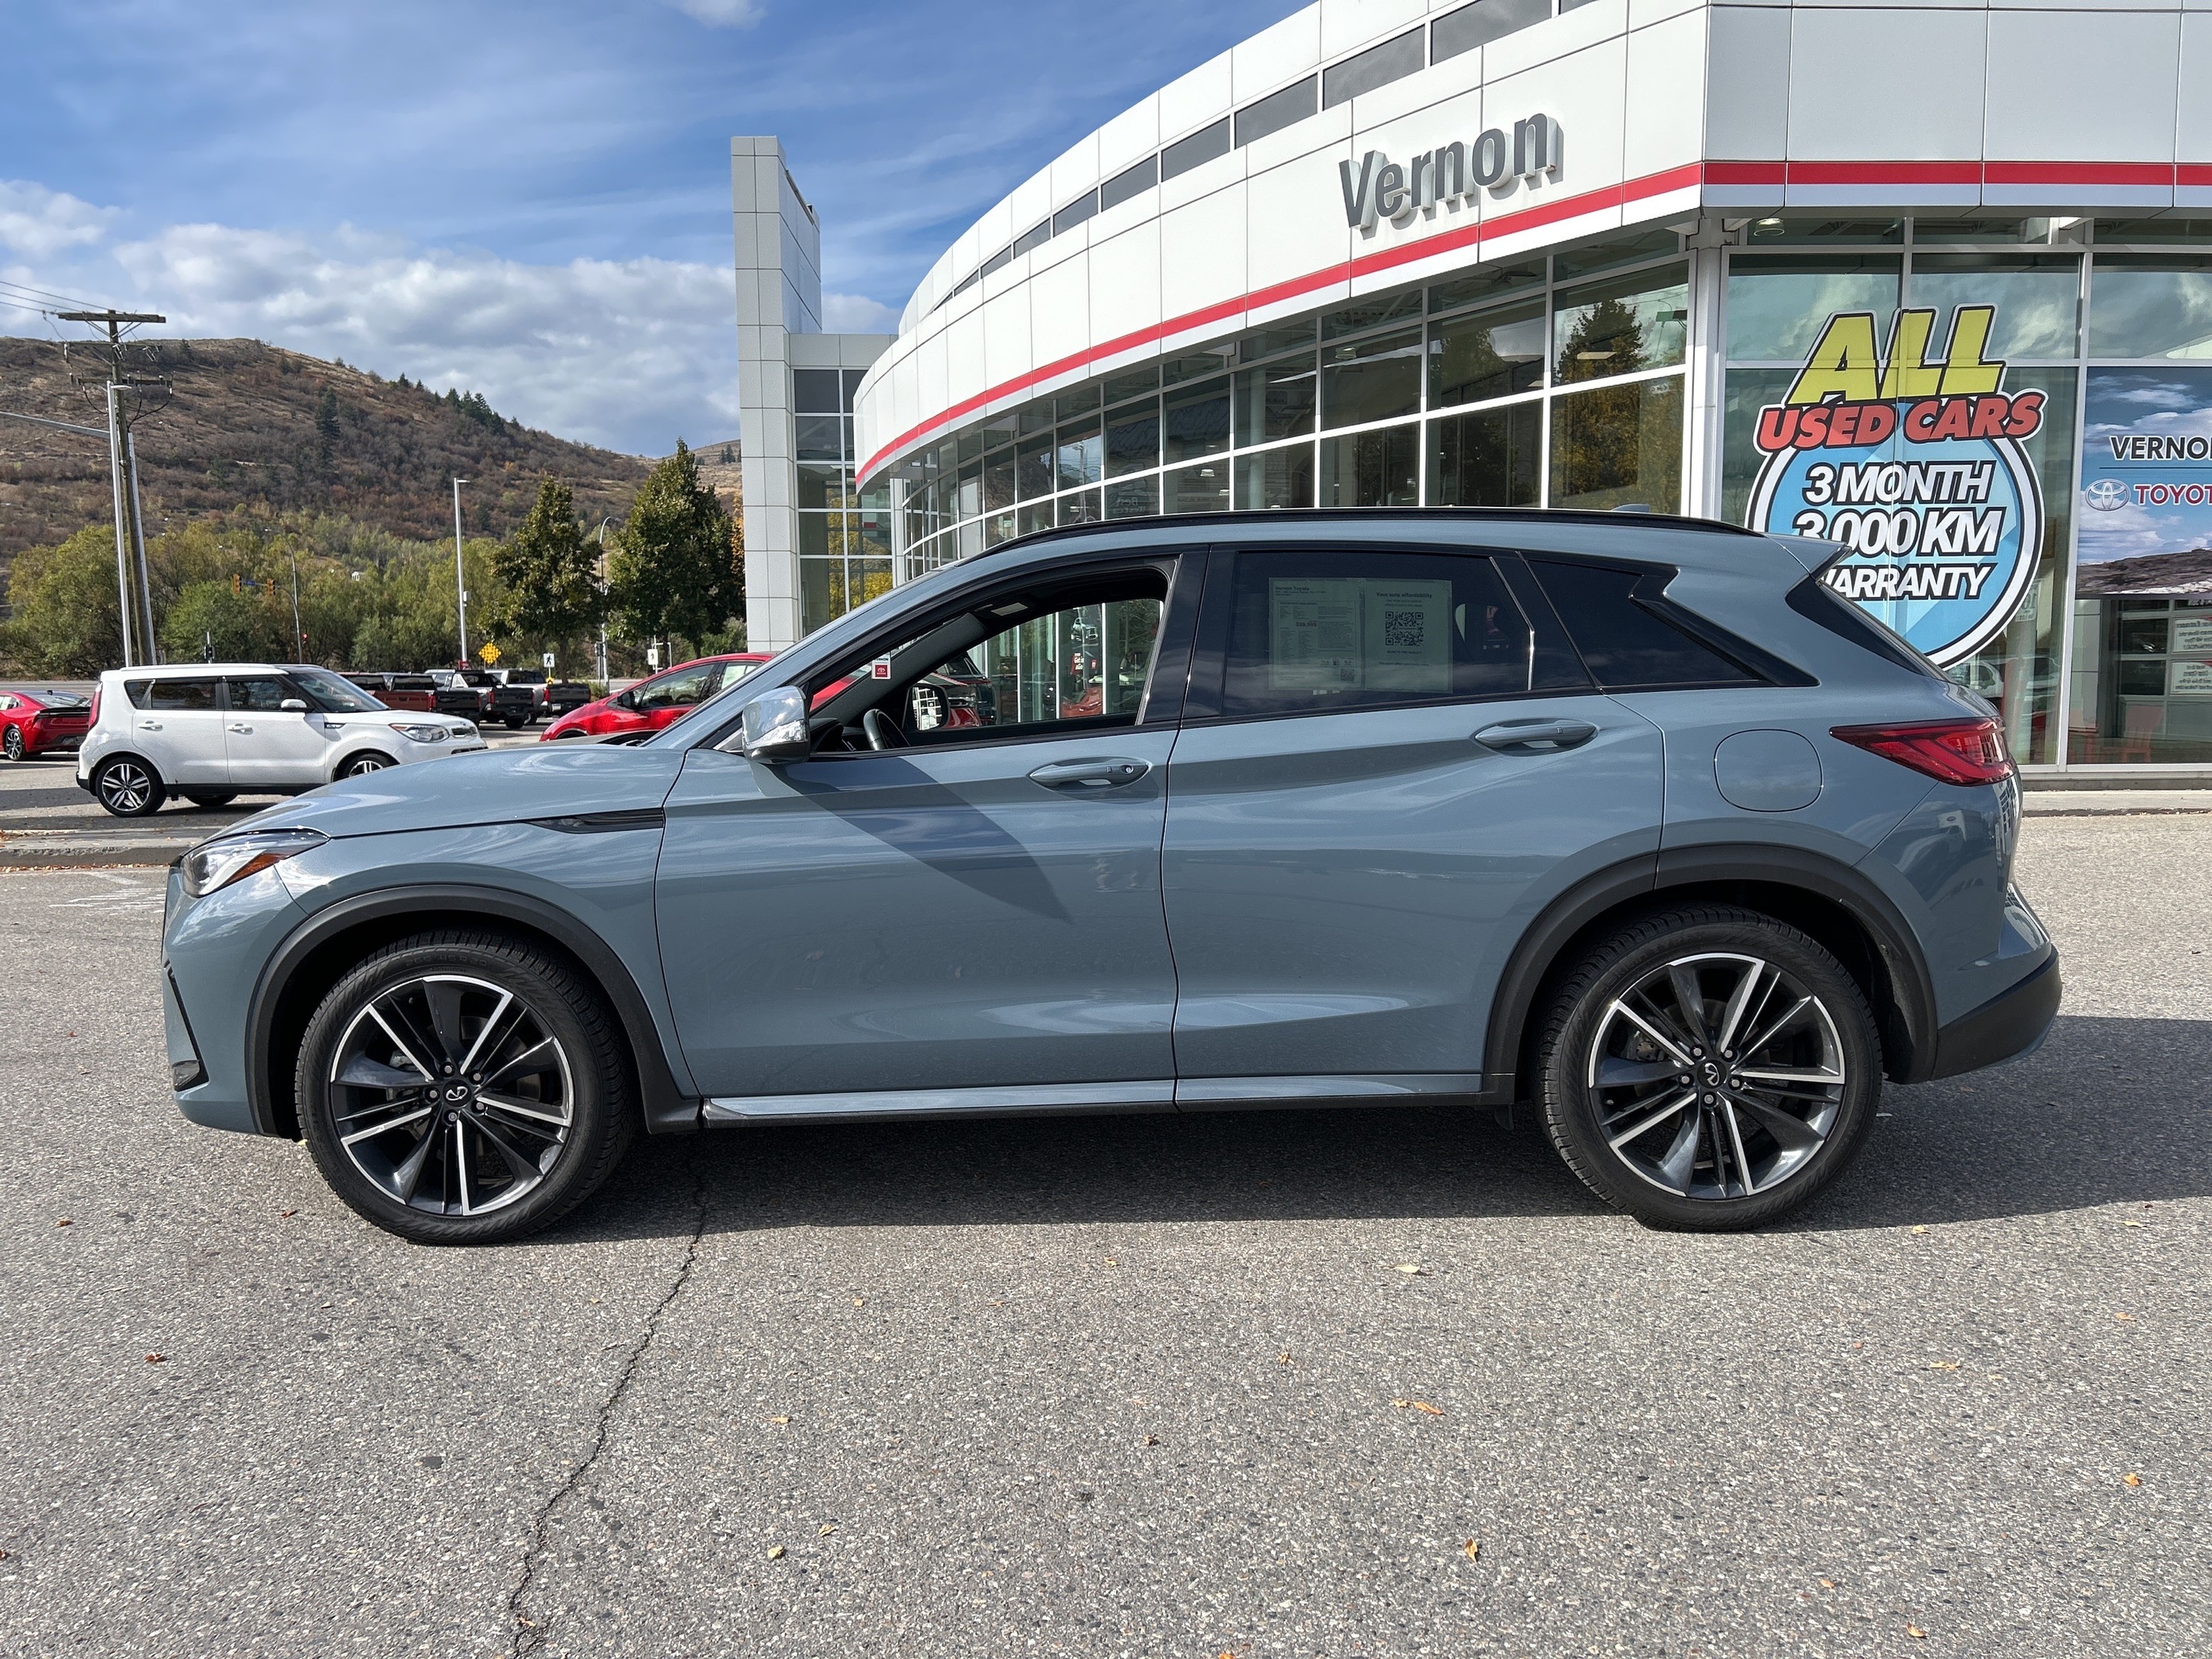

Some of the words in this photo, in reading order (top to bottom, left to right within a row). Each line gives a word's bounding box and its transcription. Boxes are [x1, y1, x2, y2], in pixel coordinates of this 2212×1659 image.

[1339, 113, 1555, 229] Vernon
[1786, 307, 2004, 406] ALL
[1758, 404, 1896, 451] USED
[1904, 393, 2043, 442] CARS
[2111, 436, 2212, 460] VERNO
[1804, 464, 1836, 505] 3
[1834, 462, 1995, 504] MONTH
[1919, 508, 2005, 555] KM
